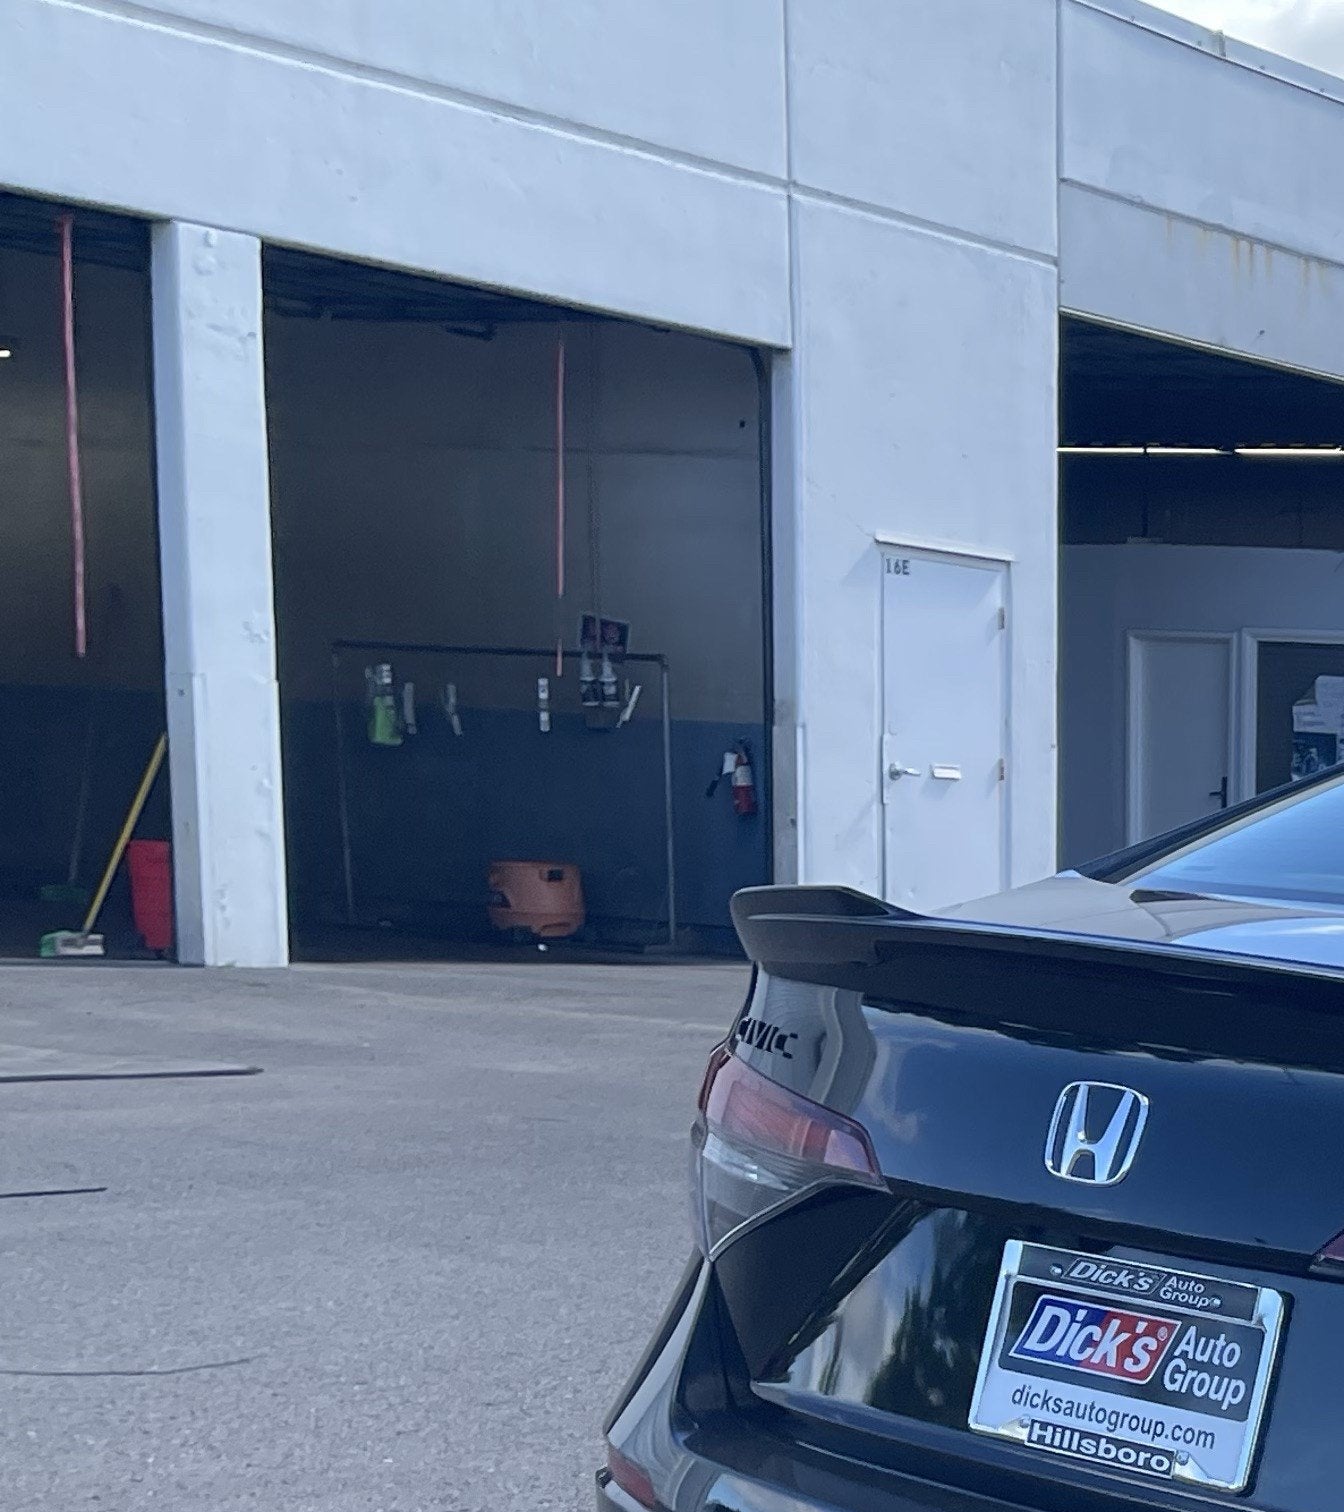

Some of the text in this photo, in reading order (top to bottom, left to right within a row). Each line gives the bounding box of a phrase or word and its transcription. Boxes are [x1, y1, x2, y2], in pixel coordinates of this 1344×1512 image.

[1069, 1261, 1155, 1292] Dick's
[1160, 1287, 1211, 1309] Group
[1165, 1276, 1206, 1293] Auto
[1023, 1305, 1158, 1374] Dick's
[1174, 1325, 1241, 1368] Auto
[1163, 1358, 1246, 1411] Group
[1011, 1384, 1216, 1450] dicksautogroup.com
[1030, 1422, 1171, 1473] Hillsboro
